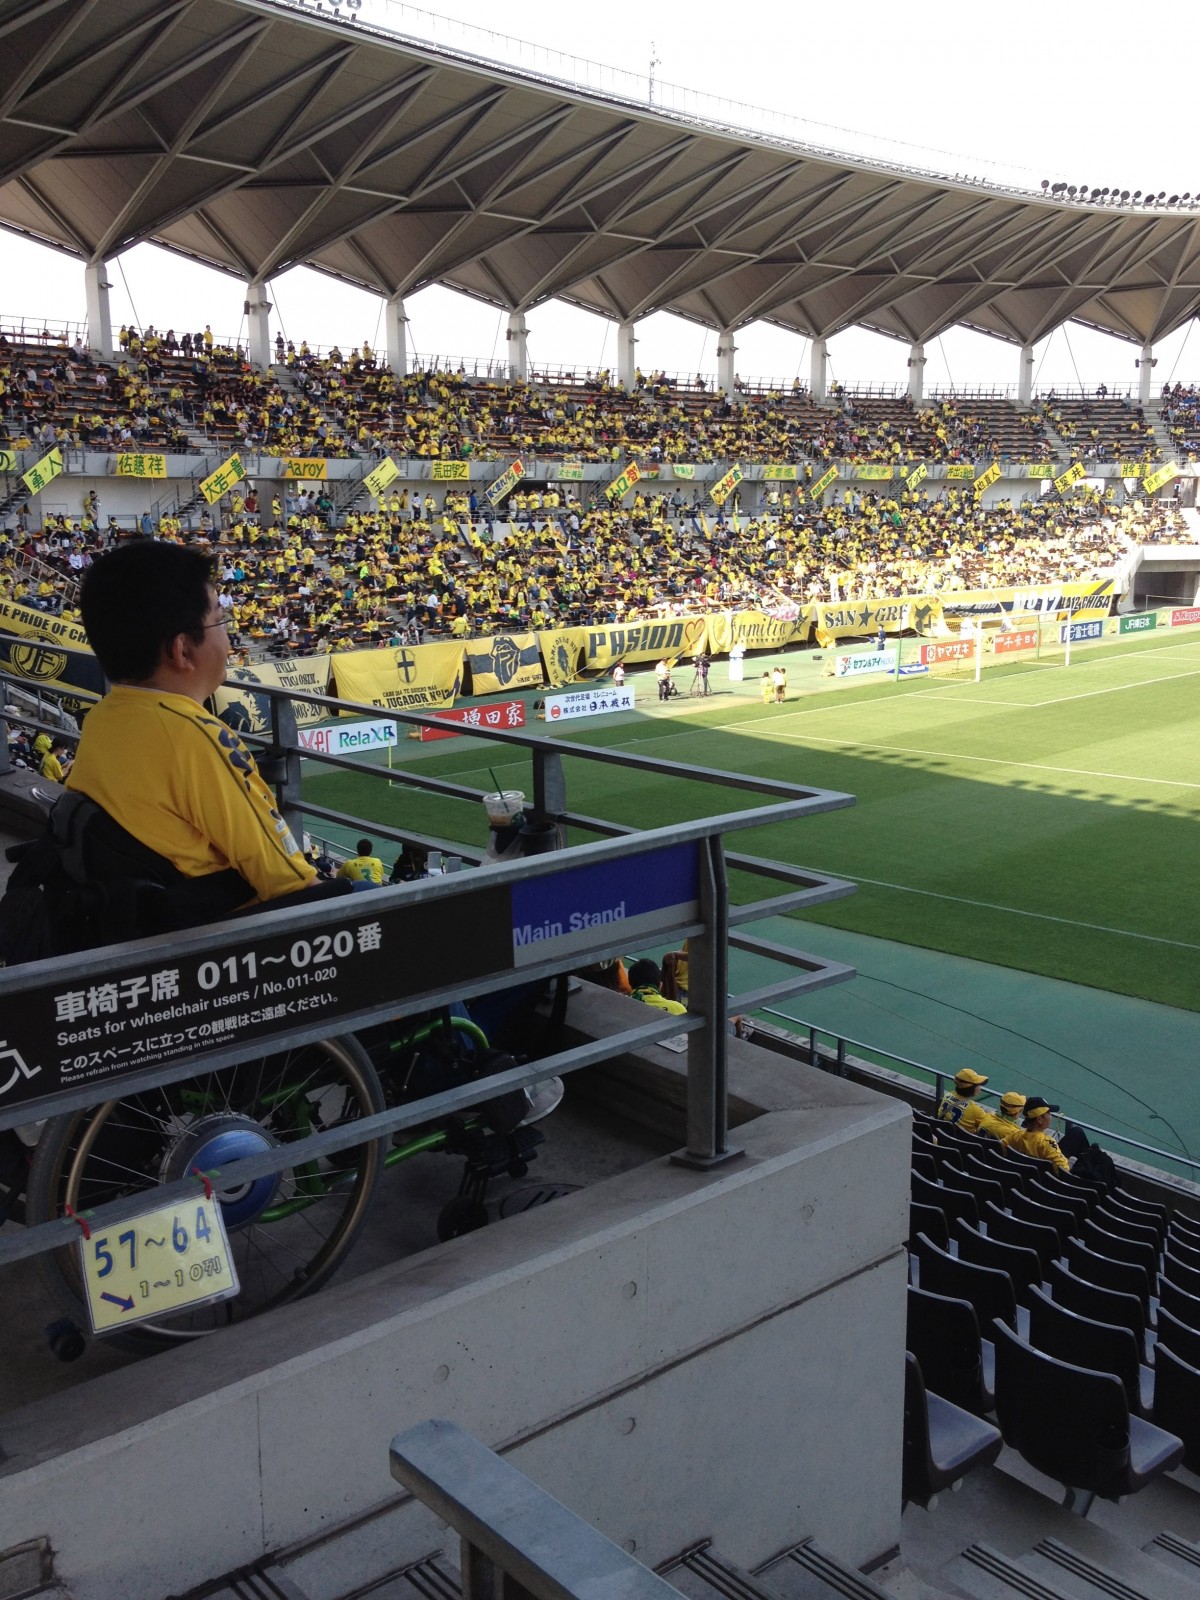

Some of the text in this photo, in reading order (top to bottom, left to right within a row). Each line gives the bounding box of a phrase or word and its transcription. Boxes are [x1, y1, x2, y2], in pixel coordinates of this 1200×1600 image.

[119, 454, 164, 476] 佐藤祥
[11, 608, 51, 631] PRIDE
[51, 622, 69, 636] OF
[69, 628, 90, 645] CH
[825, 610, 857, 629] SAN
[387, 693, 429, 709] JUGADOR
[513, 901, 626, 947] Main Stand
[54, 968, 180, 1023] 車椅子席
[57, 1026, 102, 1046] Seats
[105, 1020, 127, 1035] for
[130, 998, 208, 1028] wheelchair
[213, 990, 250, 1008] users
[60, 1073, 85, 1084] Please
[86, 1066, 110, 1077] refrain
[111, 1061, 129, 1070] from
[130, 1052, 162, 1066] watching
[163, 1044, 193, 1056] standing
[194, 1041, 201, 1049] in
[202, 1037, 215, 1047] this
